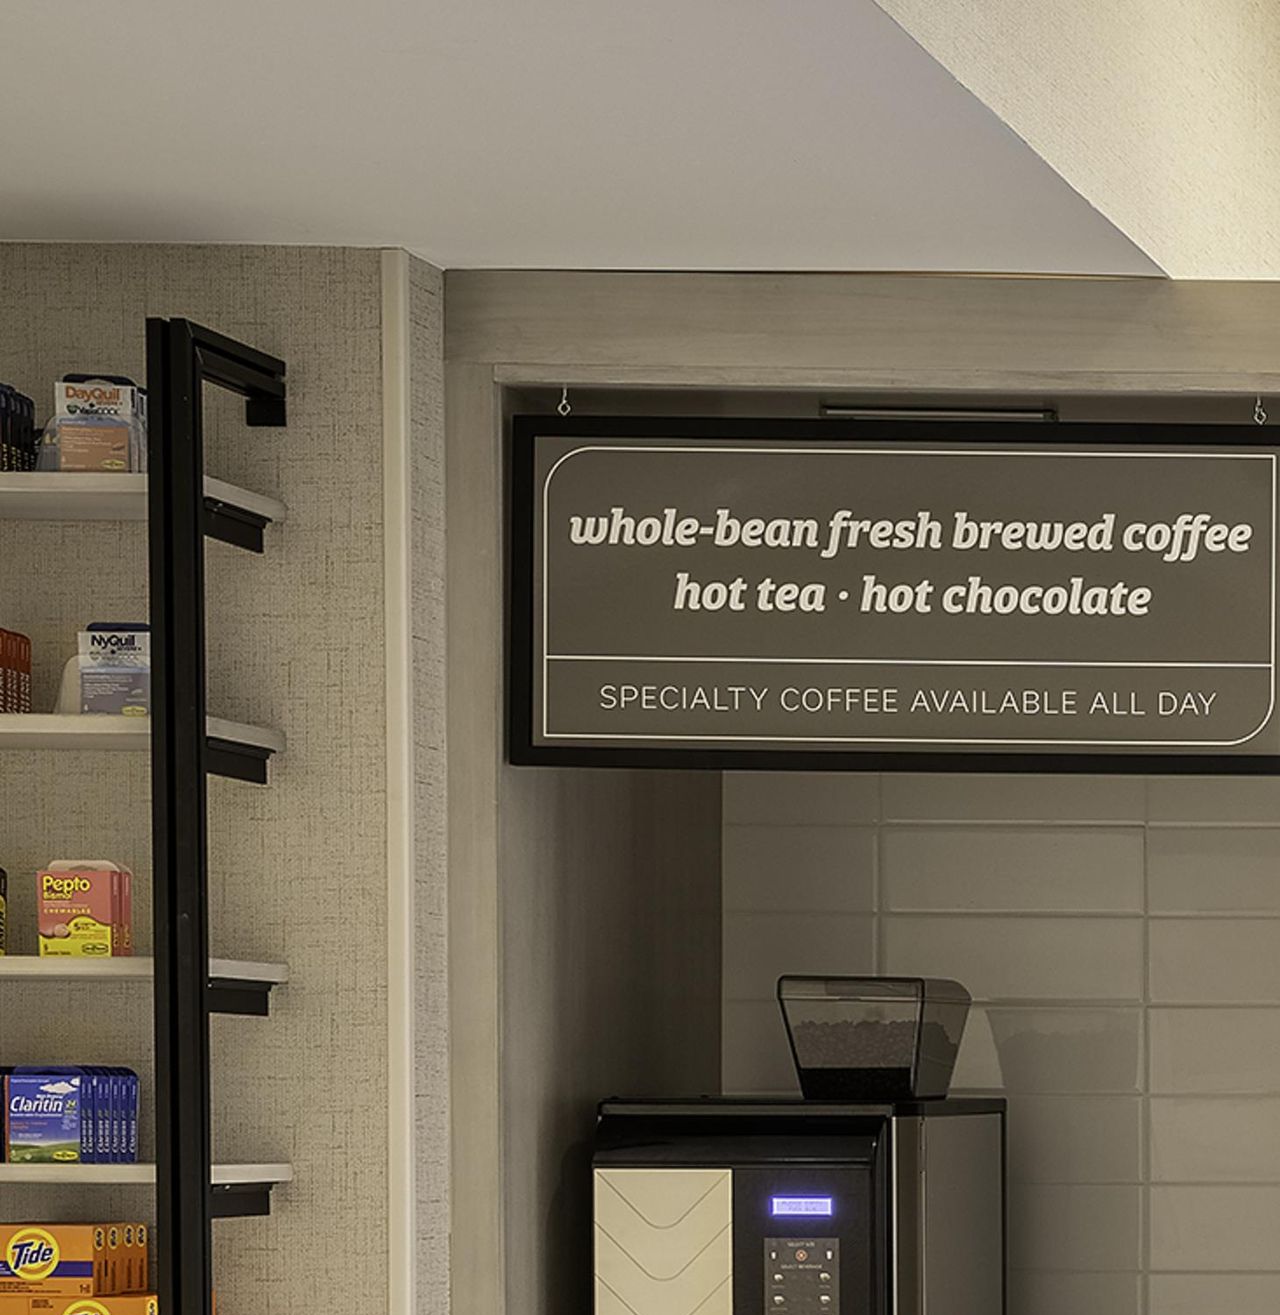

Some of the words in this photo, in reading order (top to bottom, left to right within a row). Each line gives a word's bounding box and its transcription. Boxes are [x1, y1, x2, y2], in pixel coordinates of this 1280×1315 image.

[65, 385, 120, 403] DayQuil
[568, 507, 819, 546] whole-bean
[820, 508, 942, 557] fresh
[952, 512, 1114, 552] brewed
[1122, 514, 1253, 561] coffee
[673, 573, 746, 611] hot
[756, 577, 825, 612] tea
[860, 574, 933, 613] hot
[942, 577, 1152, 616] chocolate
[91, 634, 136, 649] NyQuil
[600, 685, 768, 711] SPECIALTY
[780, 687, 898, 712] COFFEE
[910, 689, 1077, 714] AVAILABLE
[1089, 691, 1145, 715] ALL
[1158, 692, 1216, 716] DAY
[43, 874, 91, 894] Pepto
[10, 1096, 63, 1113] Claritin
[12, 1241, 53, 1270] Tide
